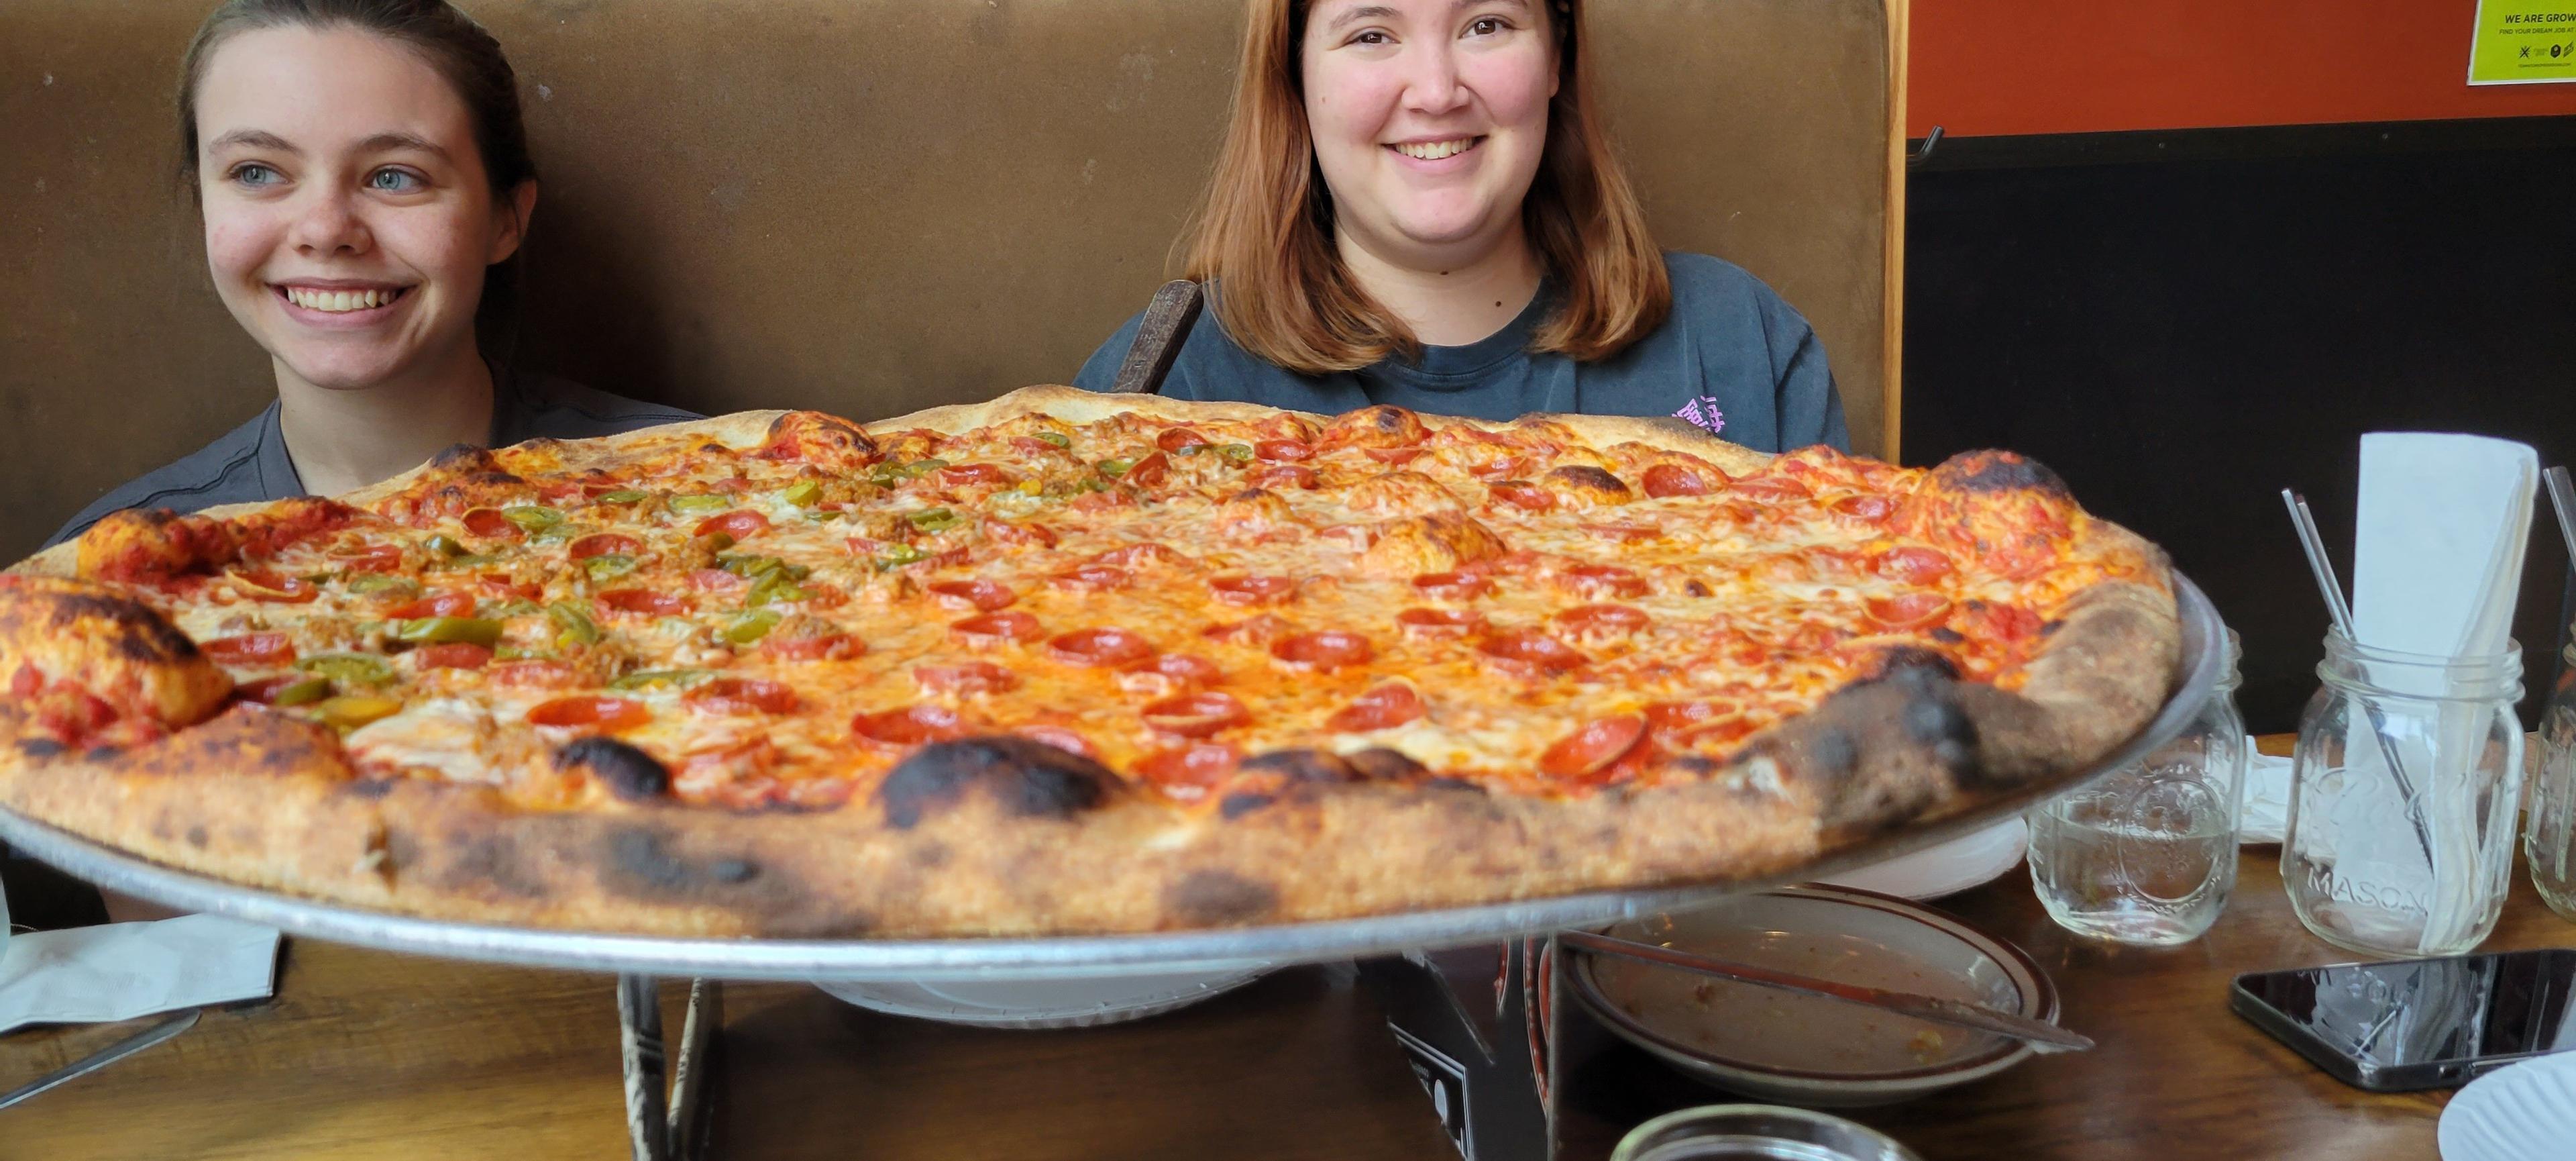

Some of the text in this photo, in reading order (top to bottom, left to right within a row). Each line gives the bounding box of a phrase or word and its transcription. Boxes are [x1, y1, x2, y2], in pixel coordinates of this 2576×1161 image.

[2506, 13, 2576, 23] WE ARE GROW
[2308, 866, 2428, 917] MASON
